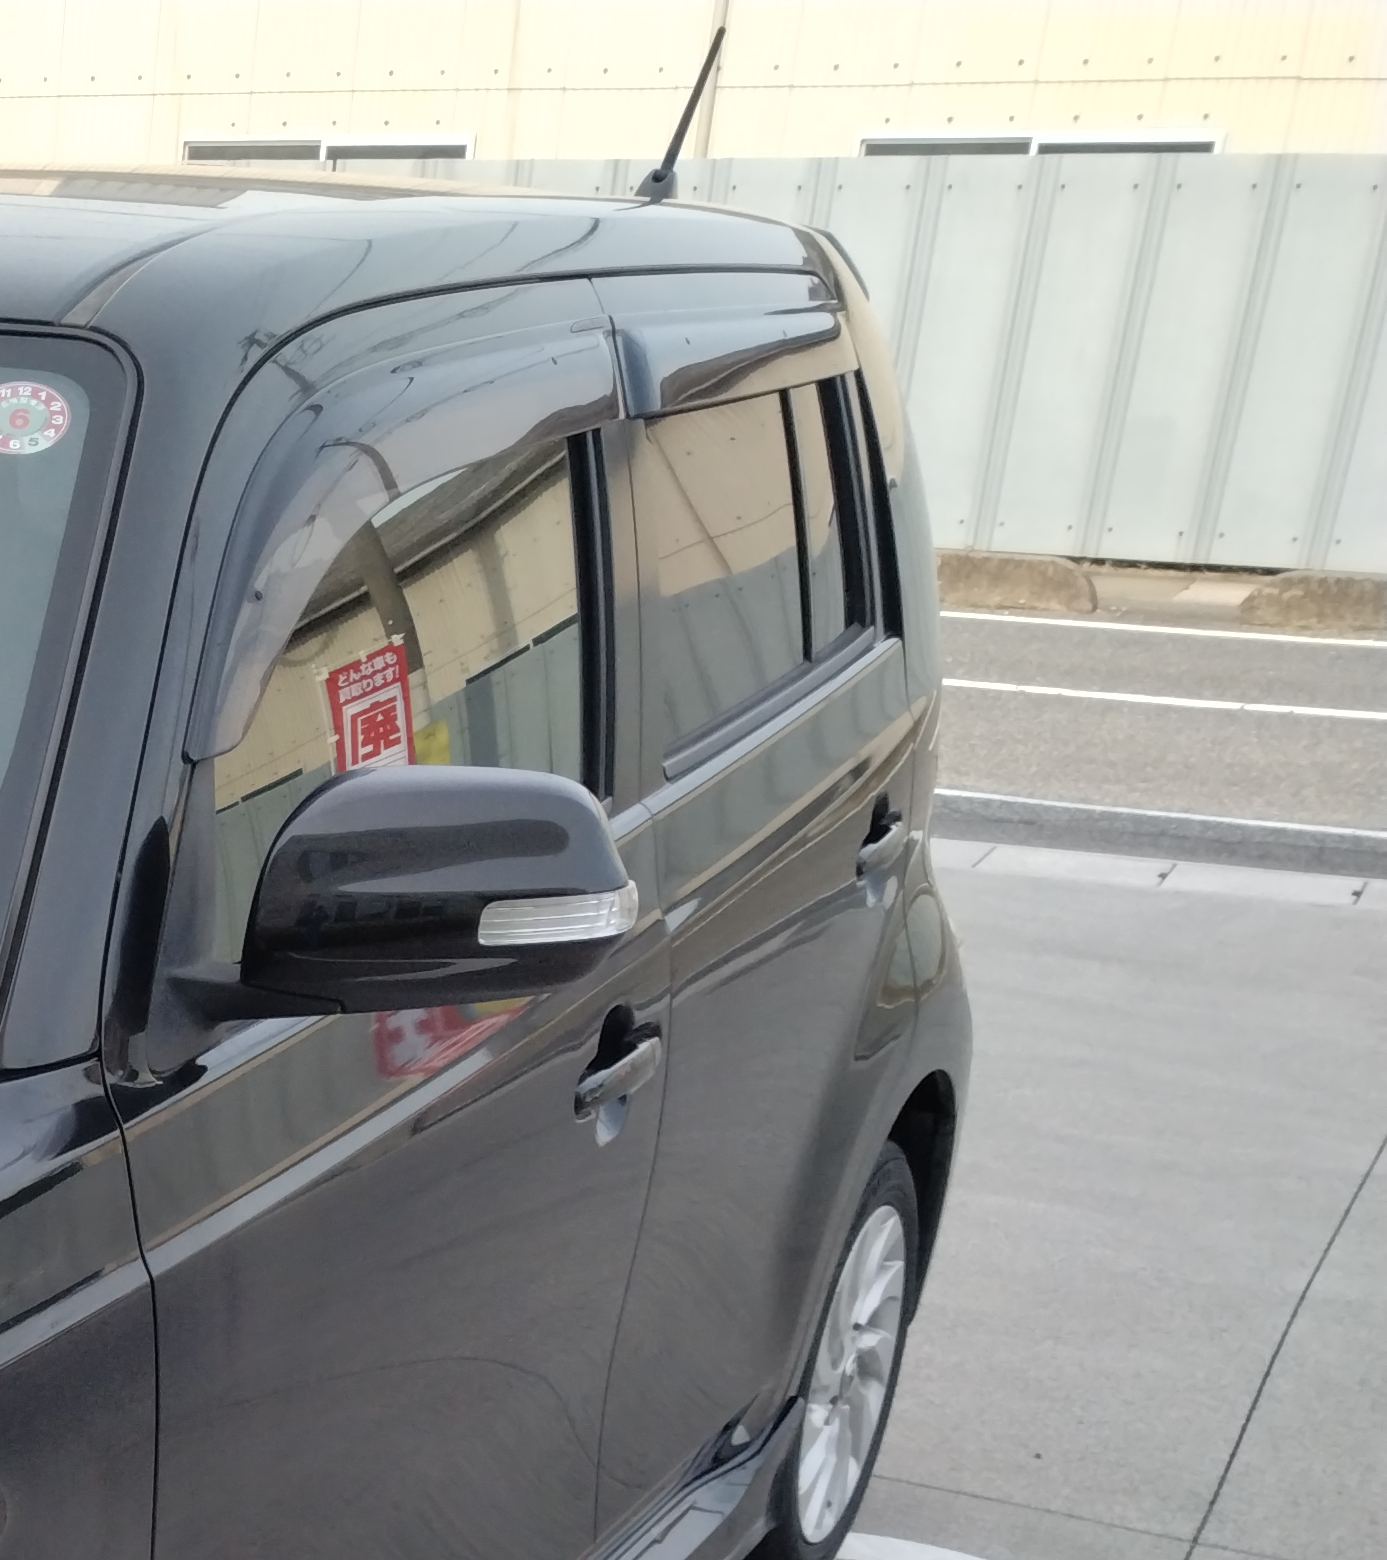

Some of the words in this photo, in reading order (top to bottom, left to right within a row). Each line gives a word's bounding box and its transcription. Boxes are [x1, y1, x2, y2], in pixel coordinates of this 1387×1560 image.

[0, 388, 12, 398] 11
[18, 386, 32, 396] 12
[38, 391, 47, 401] 1
[50, 401, 62, 411] 2
[9, 408, 30, 430] 6
[51, 415, 64, 425] 3
[43, 428, 56, 438] 4
[9, 439, 21, 449] 6
[28, 437, 40, 447] 5
